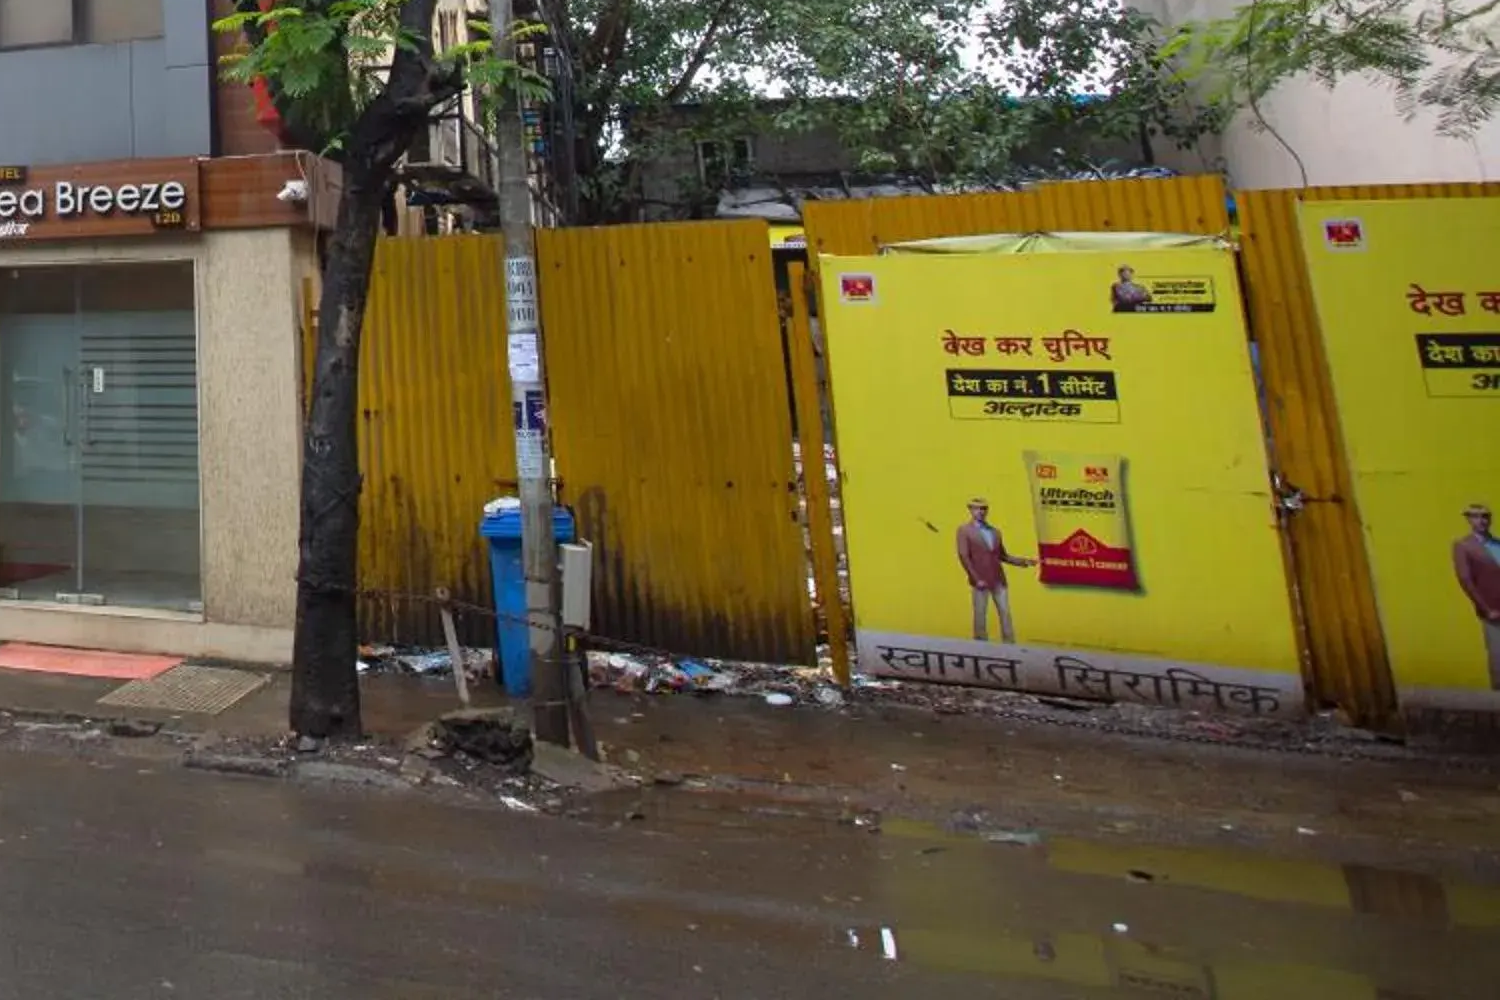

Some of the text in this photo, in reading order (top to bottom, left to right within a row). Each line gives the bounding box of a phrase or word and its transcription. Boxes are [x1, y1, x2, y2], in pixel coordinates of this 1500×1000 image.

[56, 181, 185, 214] Breeze
[1405, 283, 1466, 317] देख
[942, 329, 1112, 362] देख कर चुनिए
[951, 373, 981, 393] देश
[986, 378, 1009, 394] का
[1059, 376, 1107, 396] सीमेंट
[876, 645, 1282, 714] स्वागत सिरामिक
